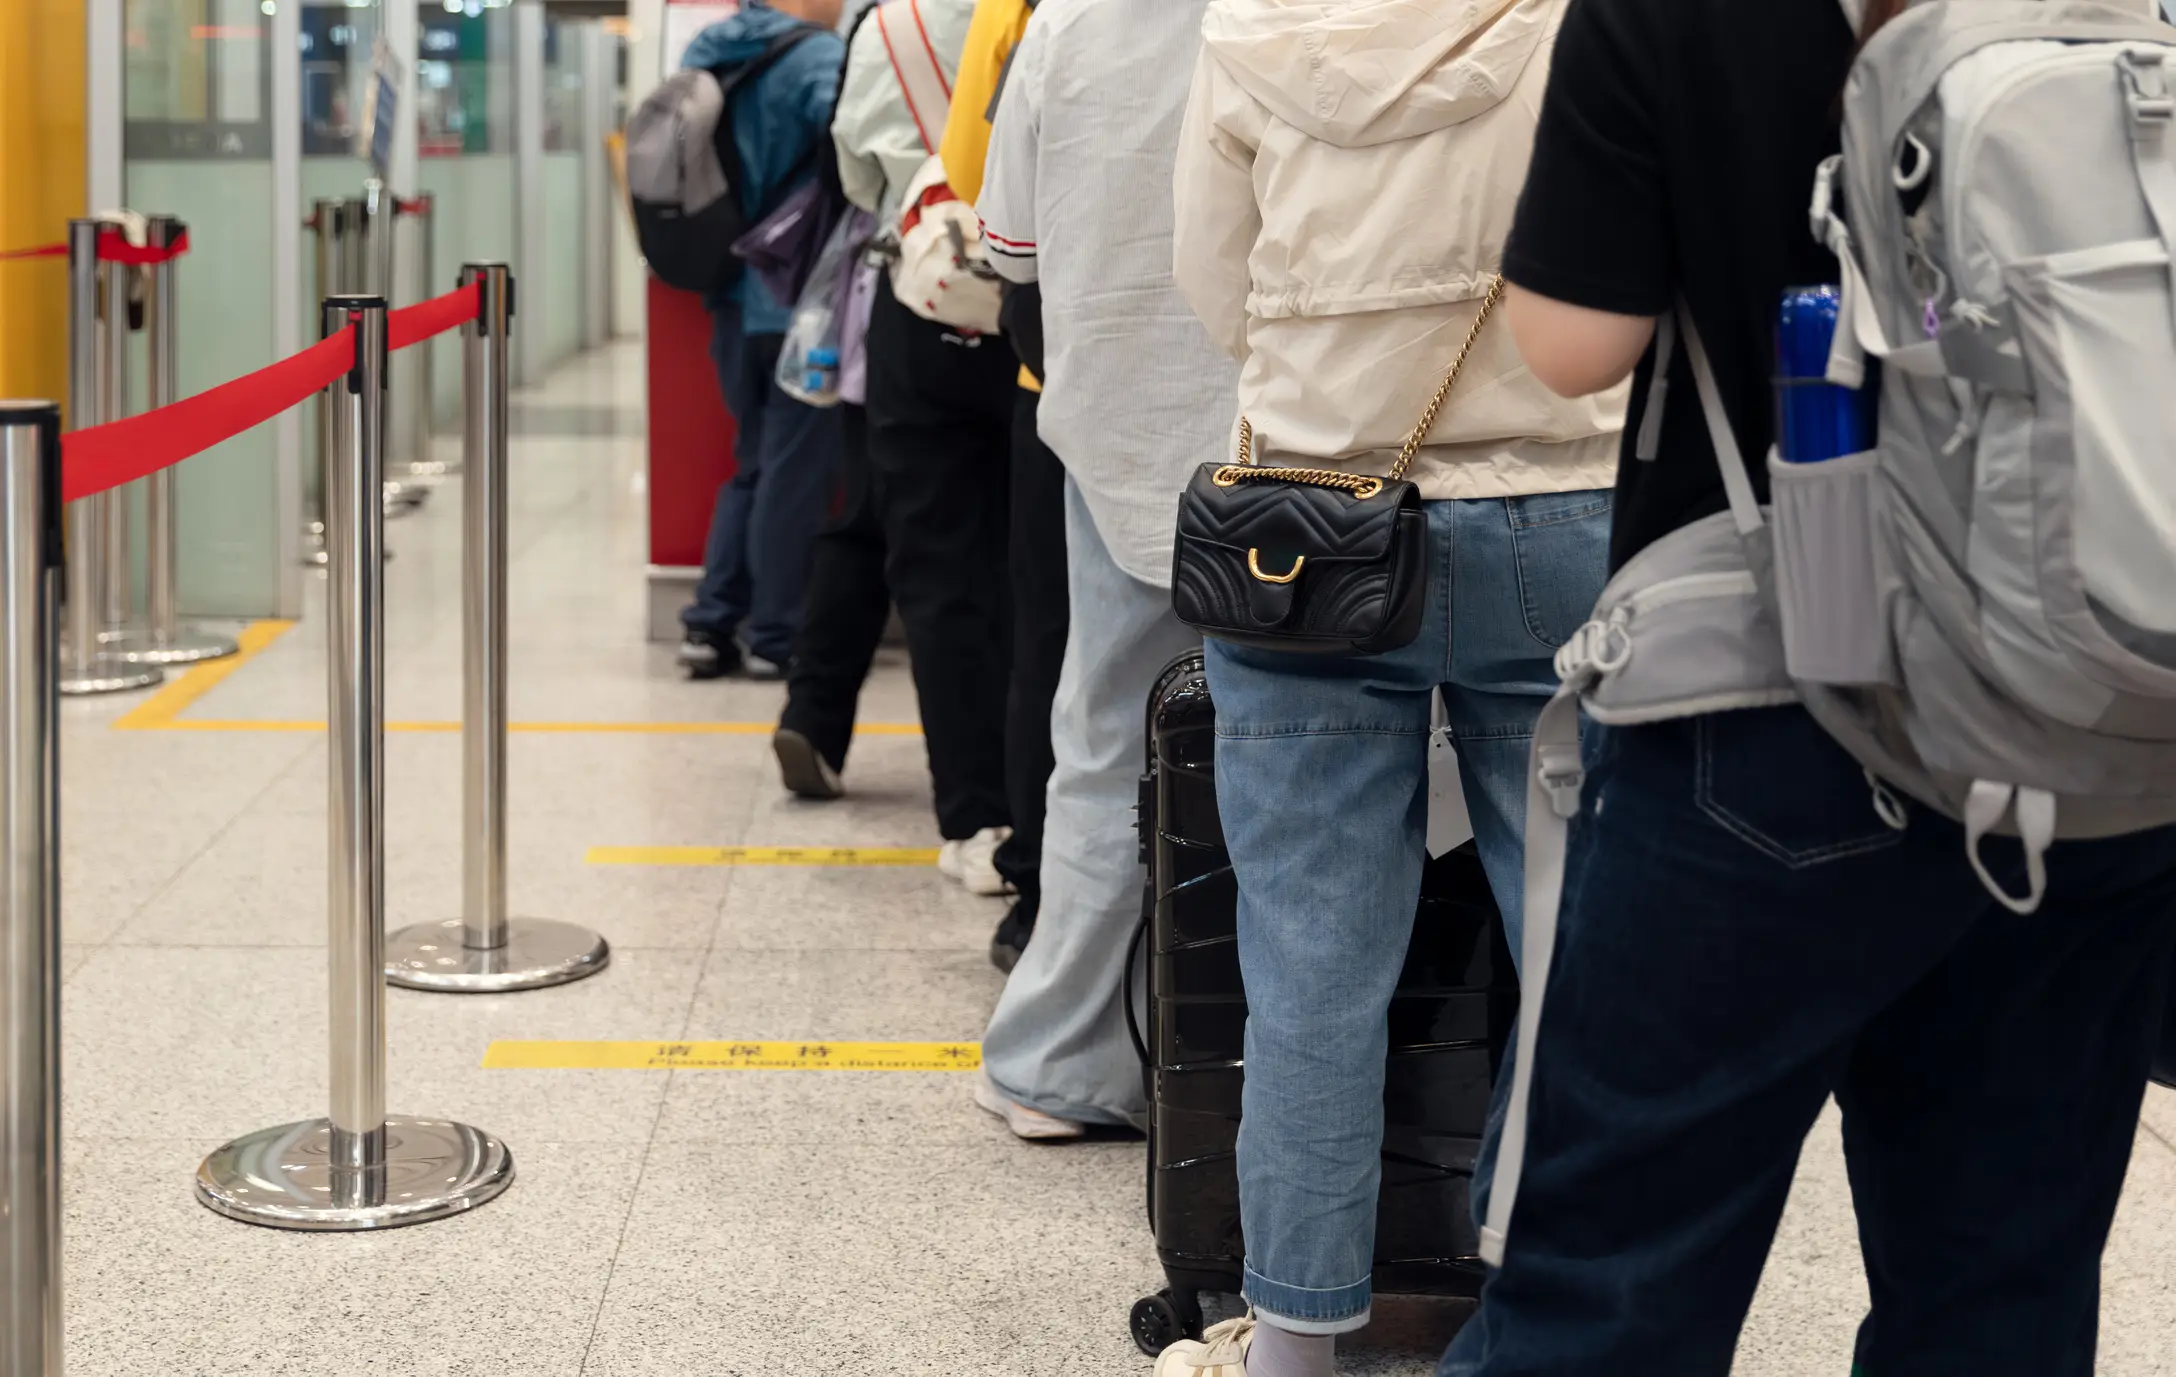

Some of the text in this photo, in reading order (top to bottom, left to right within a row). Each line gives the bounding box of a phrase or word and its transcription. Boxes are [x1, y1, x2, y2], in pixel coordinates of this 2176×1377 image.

[648, 1058, 734, 1066] Please
[745, 1059, 806, 1068] keep
[840, 1059, 947, 1067] distance
